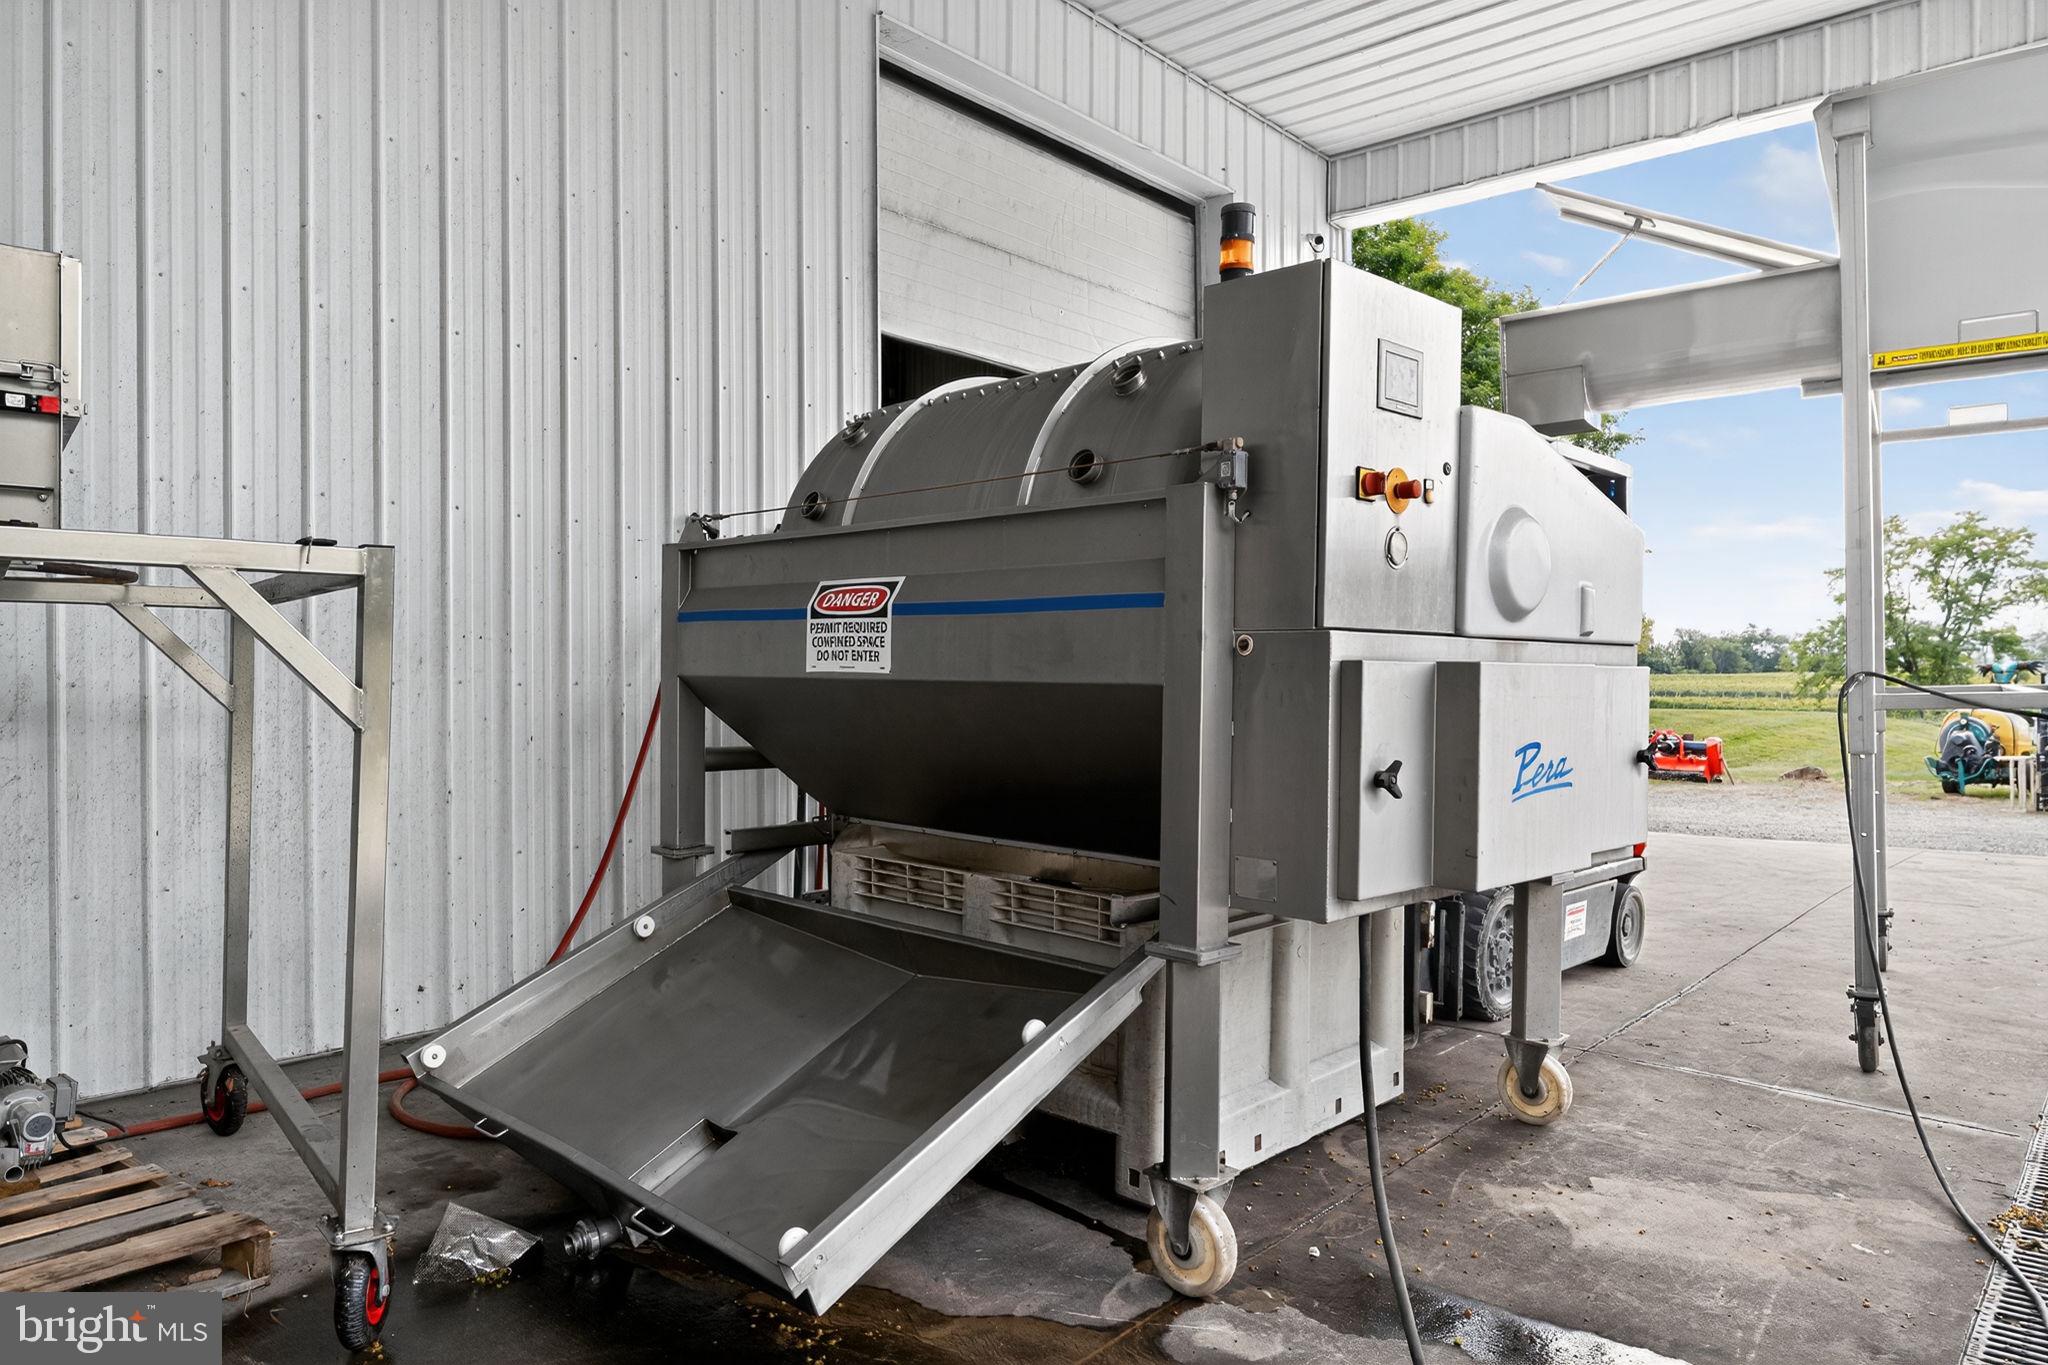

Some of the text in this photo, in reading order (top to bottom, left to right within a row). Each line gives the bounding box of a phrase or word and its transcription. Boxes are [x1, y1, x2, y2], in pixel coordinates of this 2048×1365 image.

[822, 592, 880, 608] DANGER
[810, 621, 888, 634] PERMIT REQUIRED
[812, 636, 885, 648] CONFINED SPACE
[816, 650, 880, 662] DO NOT ENTER
[1511, 741, 1574, 796] Pera
